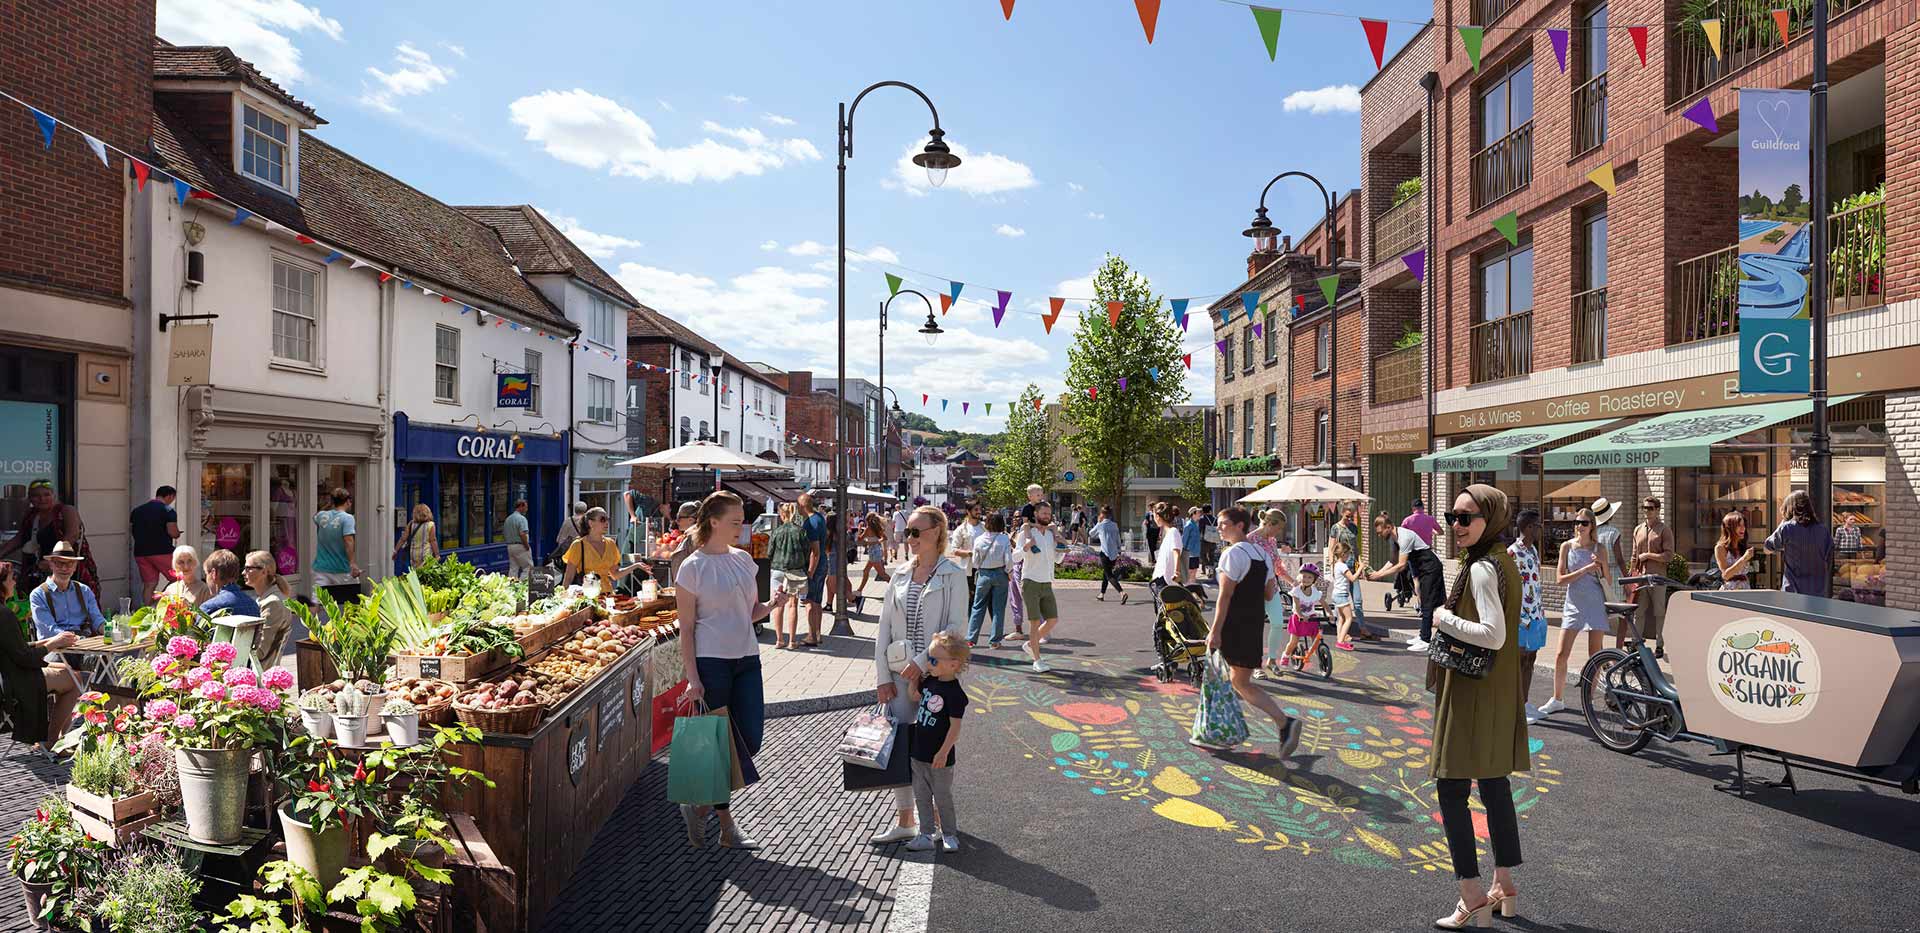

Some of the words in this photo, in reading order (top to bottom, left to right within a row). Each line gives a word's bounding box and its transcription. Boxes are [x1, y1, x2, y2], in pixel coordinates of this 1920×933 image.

[1751, 139, 1800, 151] Guildford
[173, 349, 206, 358] SAHARA
[499, 398, 529, 406] CORAL
[1546, 399, 1591, 419] Coffee
[1598, 388, 1686, 412] Roasterey
[1459, 413, 1476, 429] Deli
[1478, 411, 1486, 426] &
[1488, 409, 1522, 424] Wines
[264, 431, 324, 449] SAHARA
[457, 435, 516, 459] CORAL
[1370, 435, 1384, 450] 15
[1384, 434, 1400, 442] North
[1400, 431, 1420, 441] Street
[1384, 441, 1413, 450] Mansions
[1466, 457, 1489, 468] SHOP
[1573, 452, 1621, 465] ORGANIC
[1625, 451, 1660, 464] SHOP
[1718, 651, 1806, 684] ORGANIC
[1735, 679, 1788, 708] SHOP
